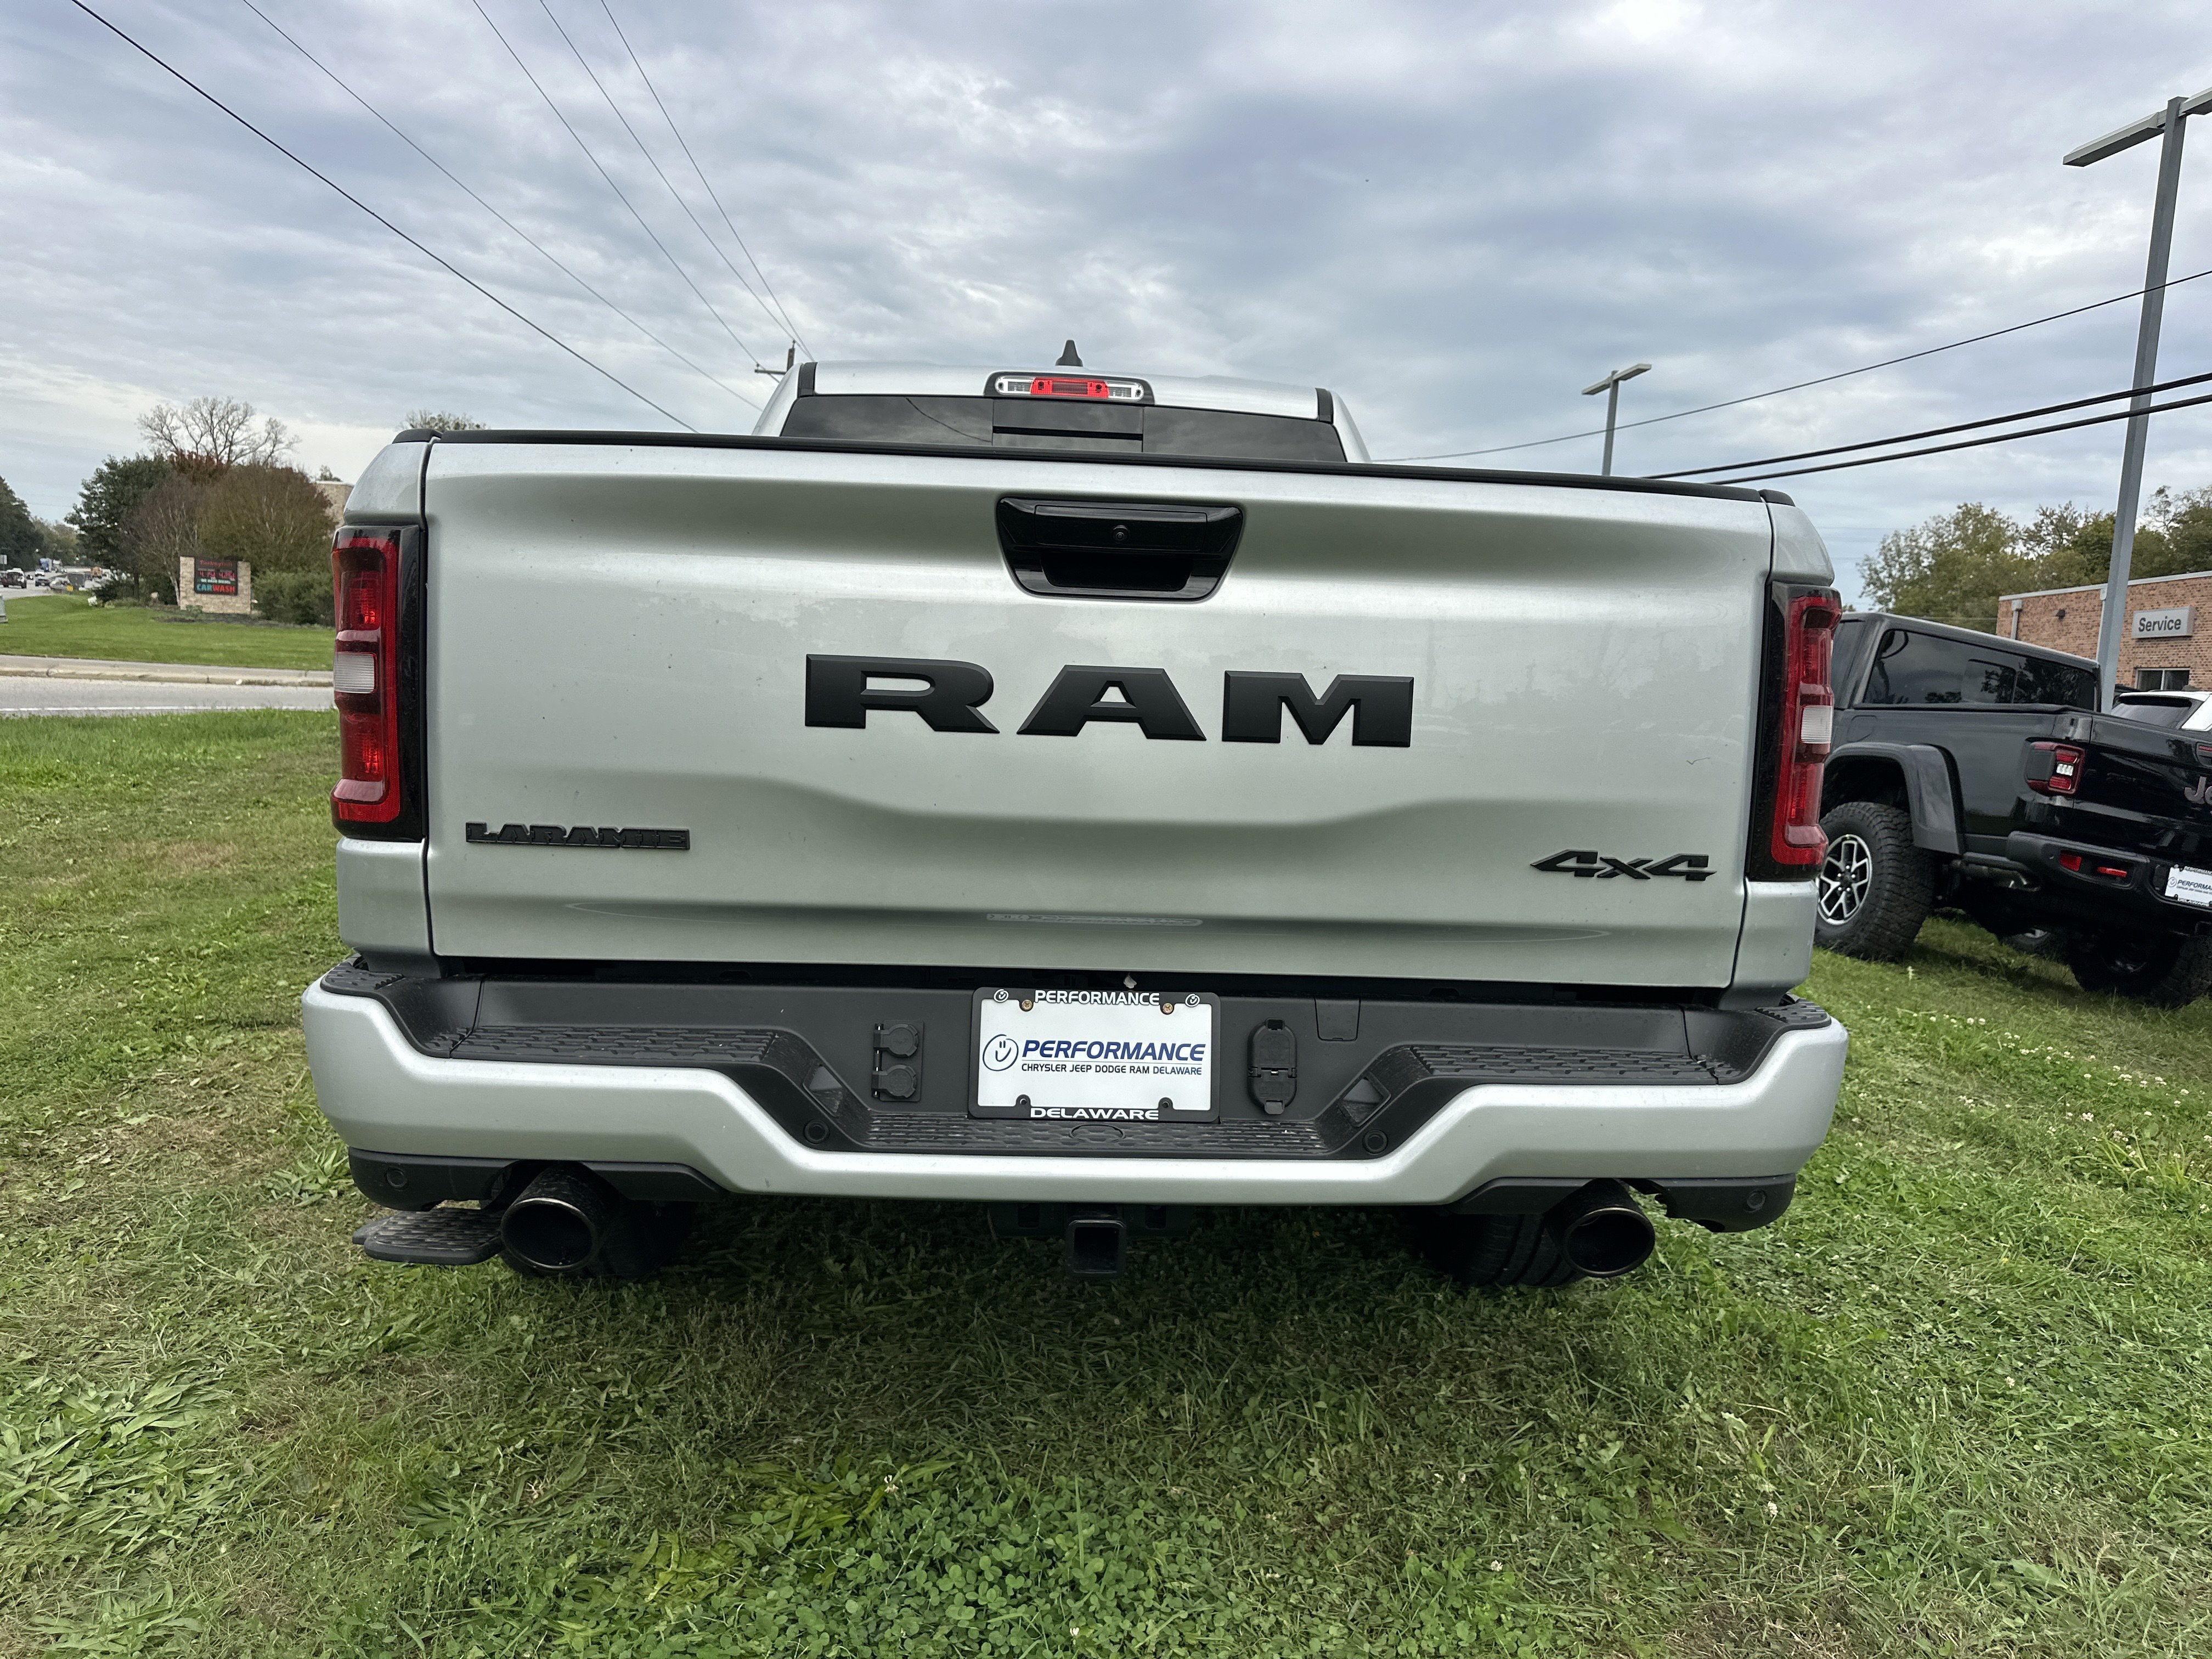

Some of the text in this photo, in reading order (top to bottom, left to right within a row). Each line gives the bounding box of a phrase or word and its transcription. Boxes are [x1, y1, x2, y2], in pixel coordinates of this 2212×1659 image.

[212, 584, 235, 593] WASH
[2138, 616, 2181, 632] Service
[805, 653, 1414, 747] RAM
[466, 821, 690, 850] LARAMIE
[1034, 990, 1160, 1006] PERFORMANCE
[1022, 1040, 1206, 1062] PERFORMANCE
[1021, 1063, 1203, 1075] CHRYSLER JEEP DODGE RAM DELAWARE
[1030, 1107, 1159, 1120] DELAWARE
